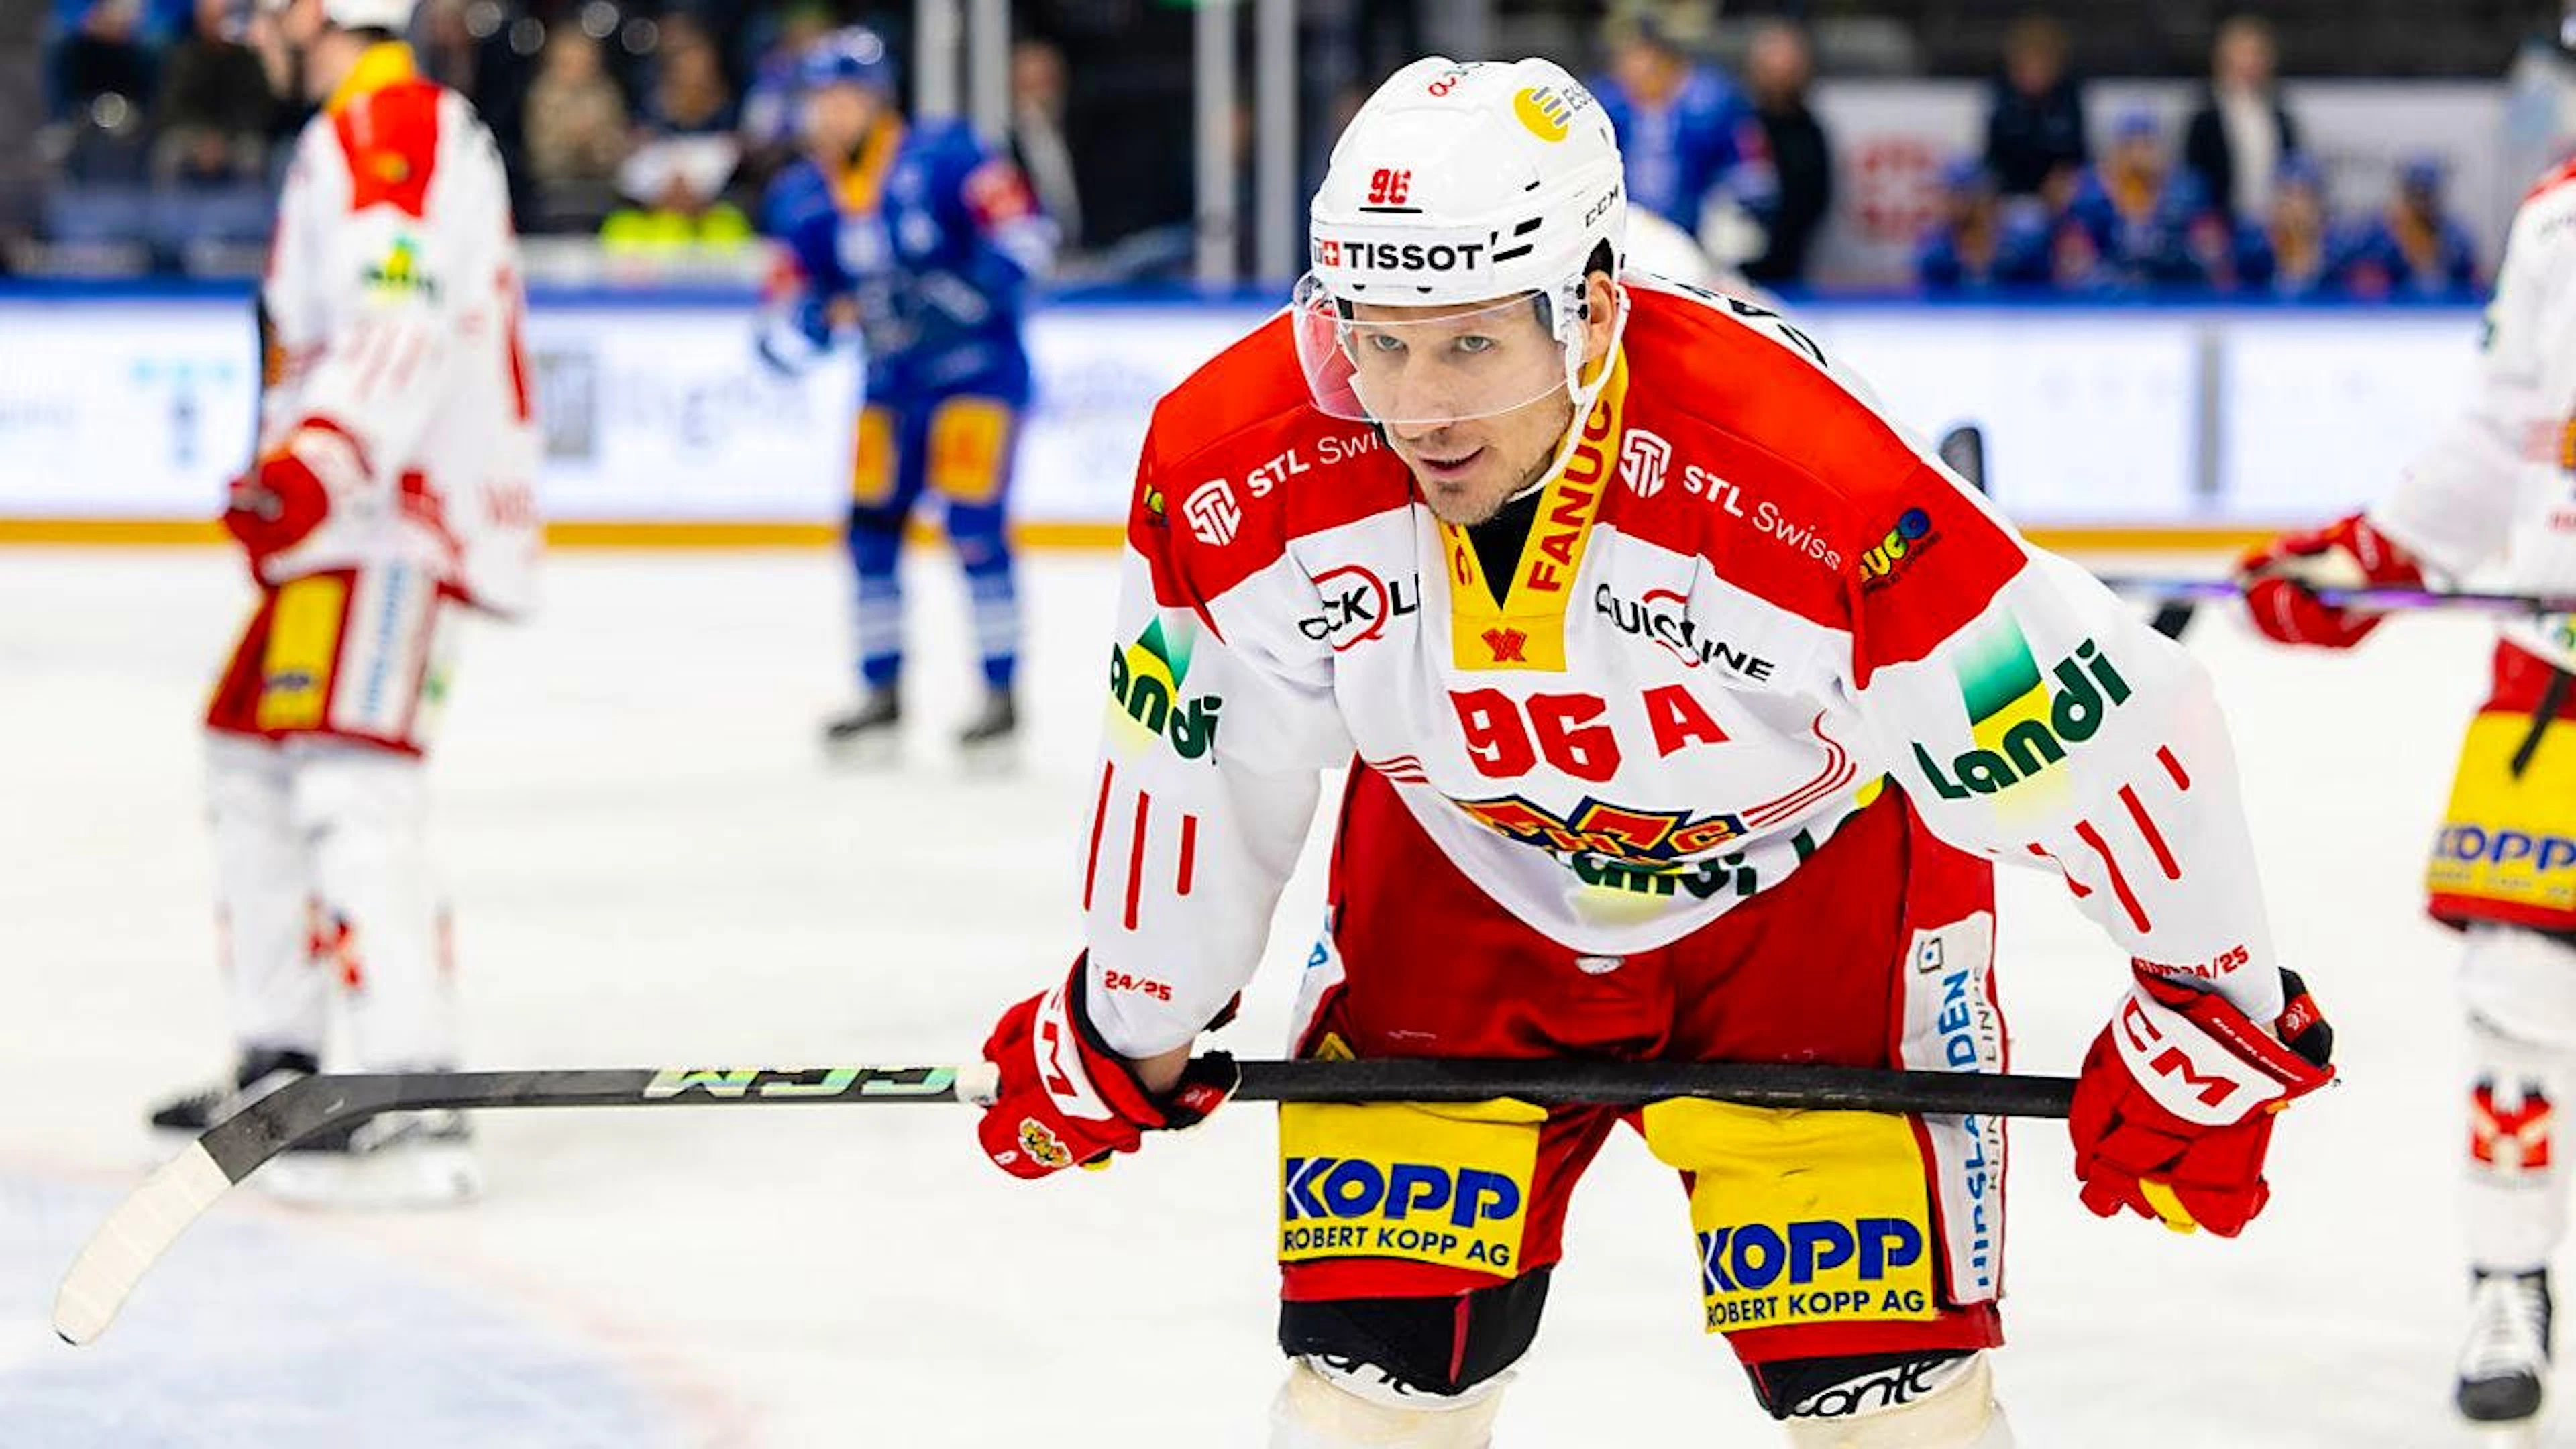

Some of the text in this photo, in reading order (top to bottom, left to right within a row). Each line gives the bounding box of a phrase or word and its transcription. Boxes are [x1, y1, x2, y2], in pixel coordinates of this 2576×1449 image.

[1368, 169, 1411, 204] 96
[1585, 184, 1619, 228] CCM
[1344, 243, 1483, 270] TISSOT
[1246, 429, 1379, 498] STL Swi
[1527, 400, 1612, 593] FANUC
[1683, 465, 1745, 519] STL
[1751, 502, 1843, 572] Swiss
[1110, 641, 1222, 765] andi
[1448, 683, 1732, 781] 96 A
[1912, 638, 2132, 800] Landi
[1104, 971, 1171, 1001] 24/25
[1285, 1157, 1521, 1228] KOPP
[1283, 1225, 1511, 1267] ROBERT KOPP AG
[1698, 1216, 1922, 1296] KOPP
[1706, 1289, 1925, 1328] ROBERT KOPP AG
